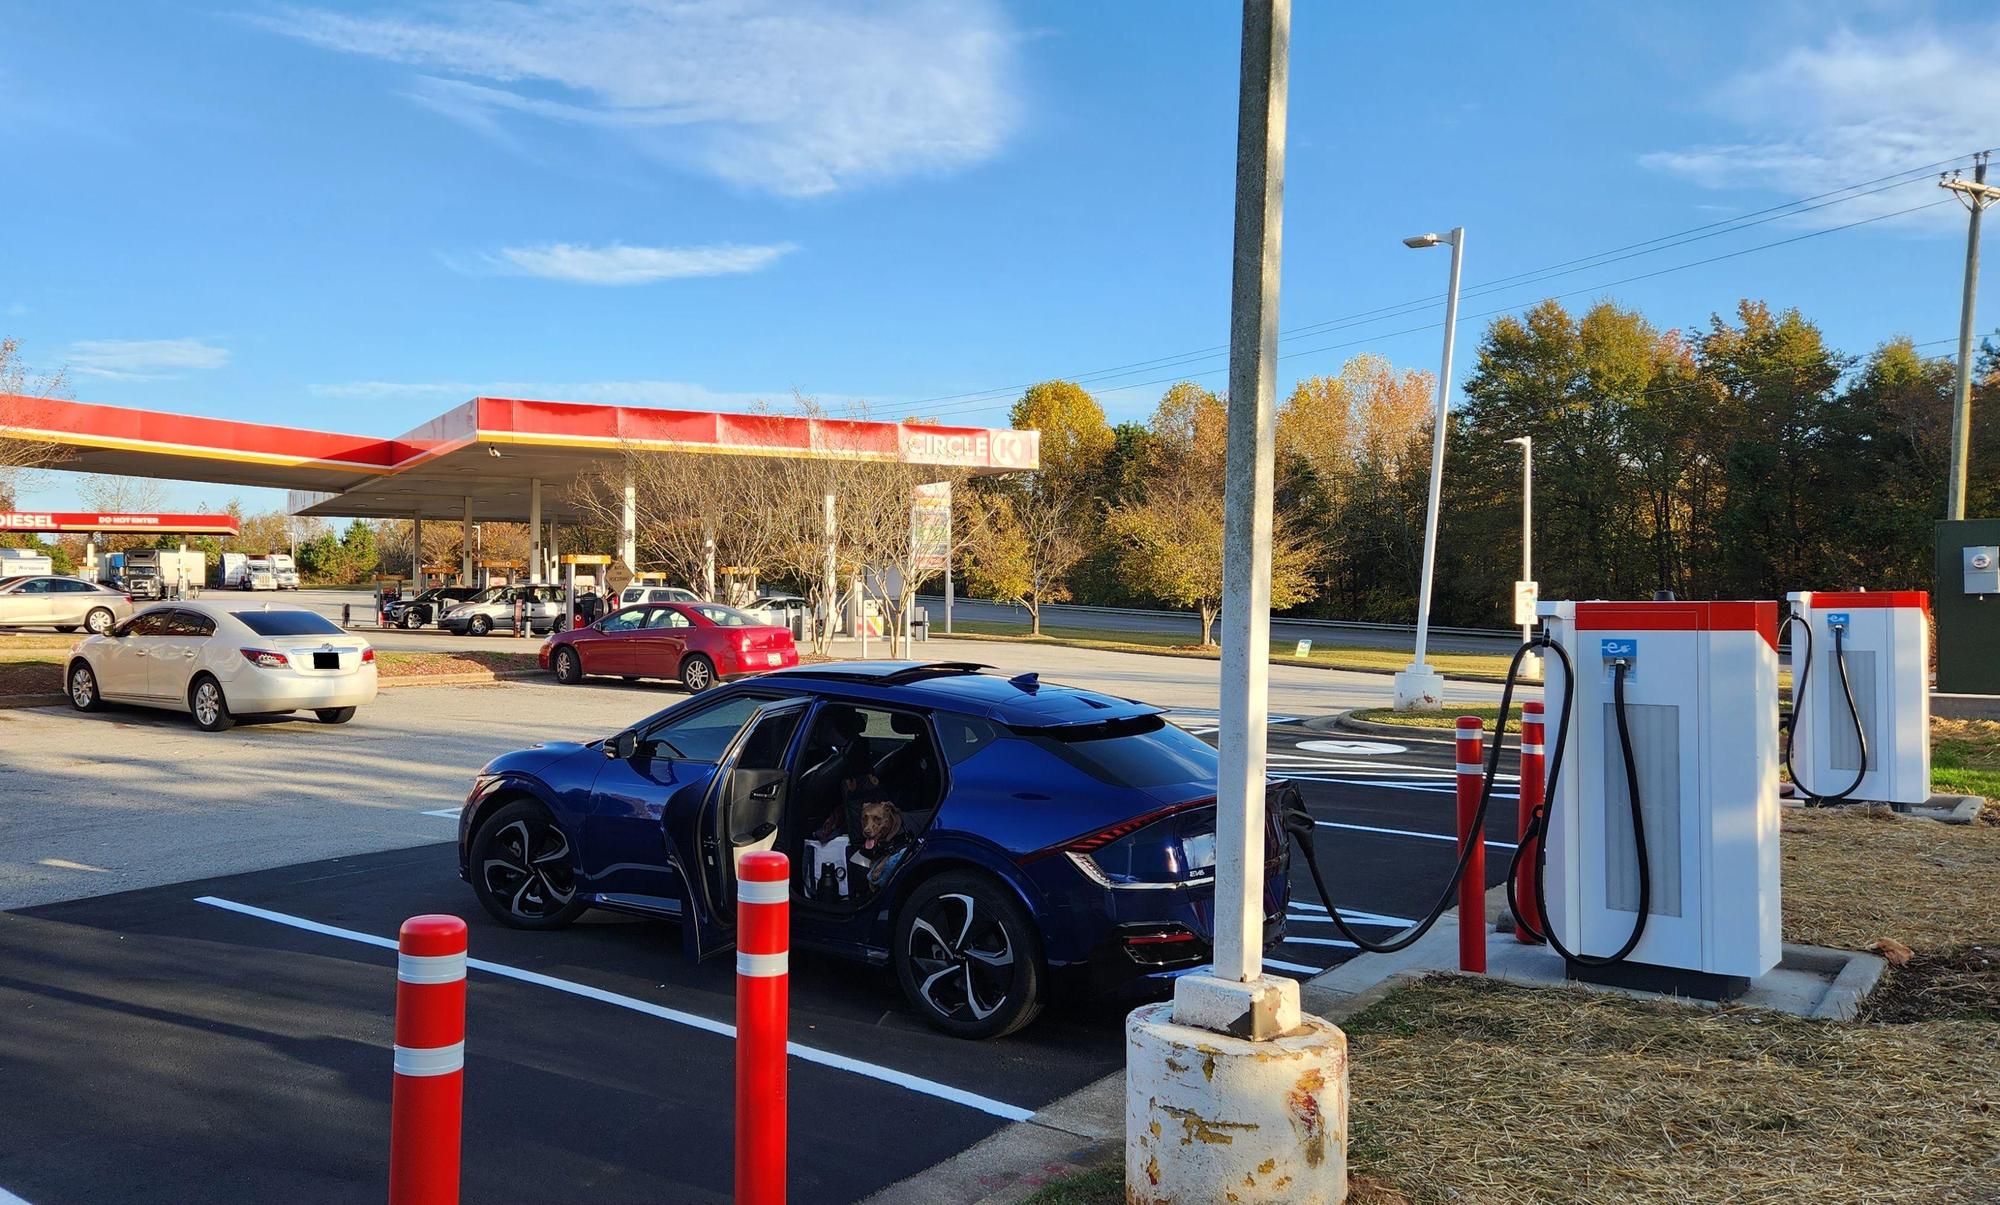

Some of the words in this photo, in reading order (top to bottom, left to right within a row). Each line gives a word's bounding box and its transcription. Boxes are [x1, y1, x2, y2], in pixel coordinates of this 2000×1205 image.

[908, 434, 988, 457] CIRCLE
[998, 436, 1020, 461] K
[98, 516, 112, 524] DO
[113, 516, 131, 524] NOT
